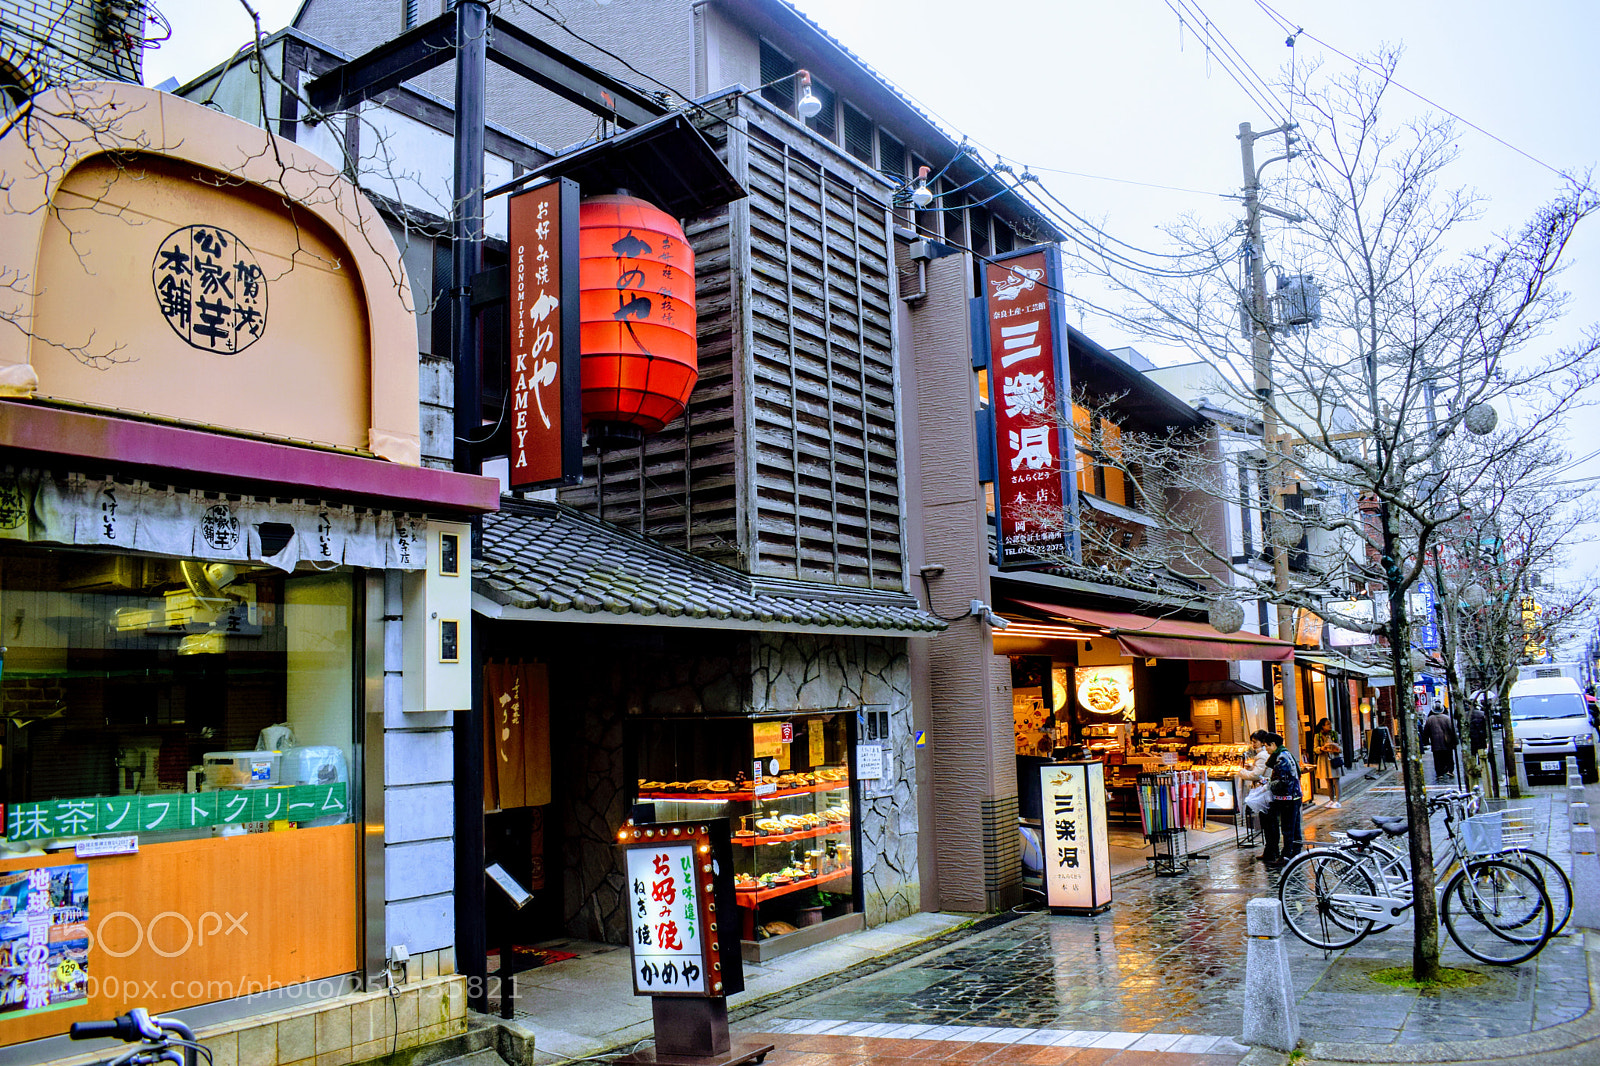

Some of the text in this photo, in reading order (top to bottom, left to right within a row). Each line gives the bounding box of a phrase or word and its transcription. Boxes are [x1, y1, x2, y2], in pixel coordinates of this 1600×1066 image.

[535, 201, 550, 286] お好み焼
[158, 244, 193, 329] 本舗
[193, 228, 234, 348] 公家芋
[232, 260, 264, 340] 賀茂
[611, 229, 654, 362] かめや
[514, 245, 528, 468] OKONOMIYAKI KAMEYA
[529, 288, 559, 430] かめや
[1011, 471, 1050, 484] さんらくどう
[1014, 488, 1049, 505] 本店
[214, 506, 230, 548] 公家芋
[9, 787, 344, 840] 抹茶ソフトクリーム
[26, 868, 50, 1010] 地球一周の船旅
[633, 878, 652, 946] ねぎ焼
[652, 853, 683, 951] お好み焼
[680, 855, 696, 940] ひと味違う
[60, 962, 76, 976] 129
[640, 960, 700, 988] かめや
